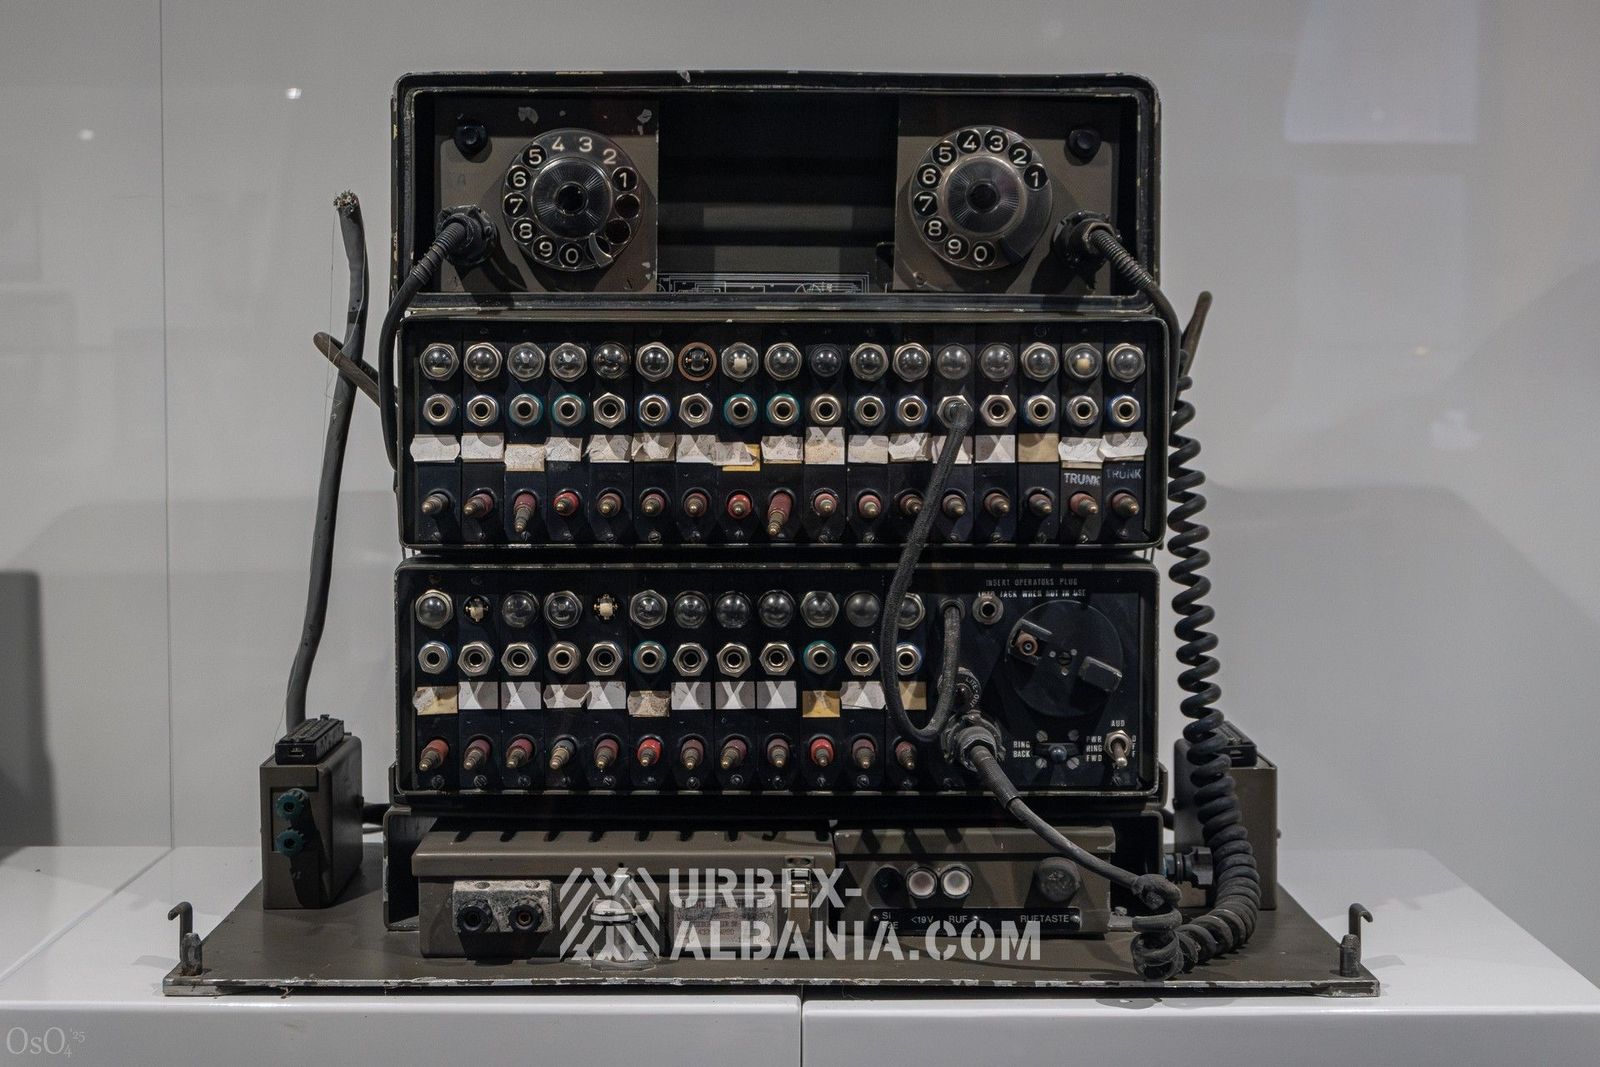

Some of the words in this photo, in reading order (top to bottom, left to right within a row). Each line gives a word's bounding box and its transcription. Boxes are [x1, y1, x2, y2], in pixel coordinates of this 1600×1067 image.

[552, 136, 565, 151] 4
[579, 136, 592, 152] 3
[963, 135, 976, 150] 4
[990, 135, 1003, 151] 3
[529, 149, 542, 164] 5
[603, 149, 616, 164] 2
[939, 147, 952, 162] 5
[1013, 148, 1027, 164] 2
[513, 171, 526, 187] 6
[619, 172, 627, 188] 1
[922, 169, 936, 184] 6
[1031, 171, 1039, 187] 1
[509, 198, 523, 214] 7
[919, 196, 933, 212] 7
[519, 223, 532, 239] 8
[928, 220, 942, 236] 8
[539, 241, 552, 257] 9
[948, 239, 962, 254] 9
[974, 246, 988, 261] 0
[565, 248, 579, 264] 0
[1064, 472, 1100, 486] TRUNK
[1106, 469, 1141, 480] TRUNK
[1013, 750, 1031, 758] BACK
[948, 915, 968, 924] RUF
[1020, 914, 1070, 923] RUFTASTE
